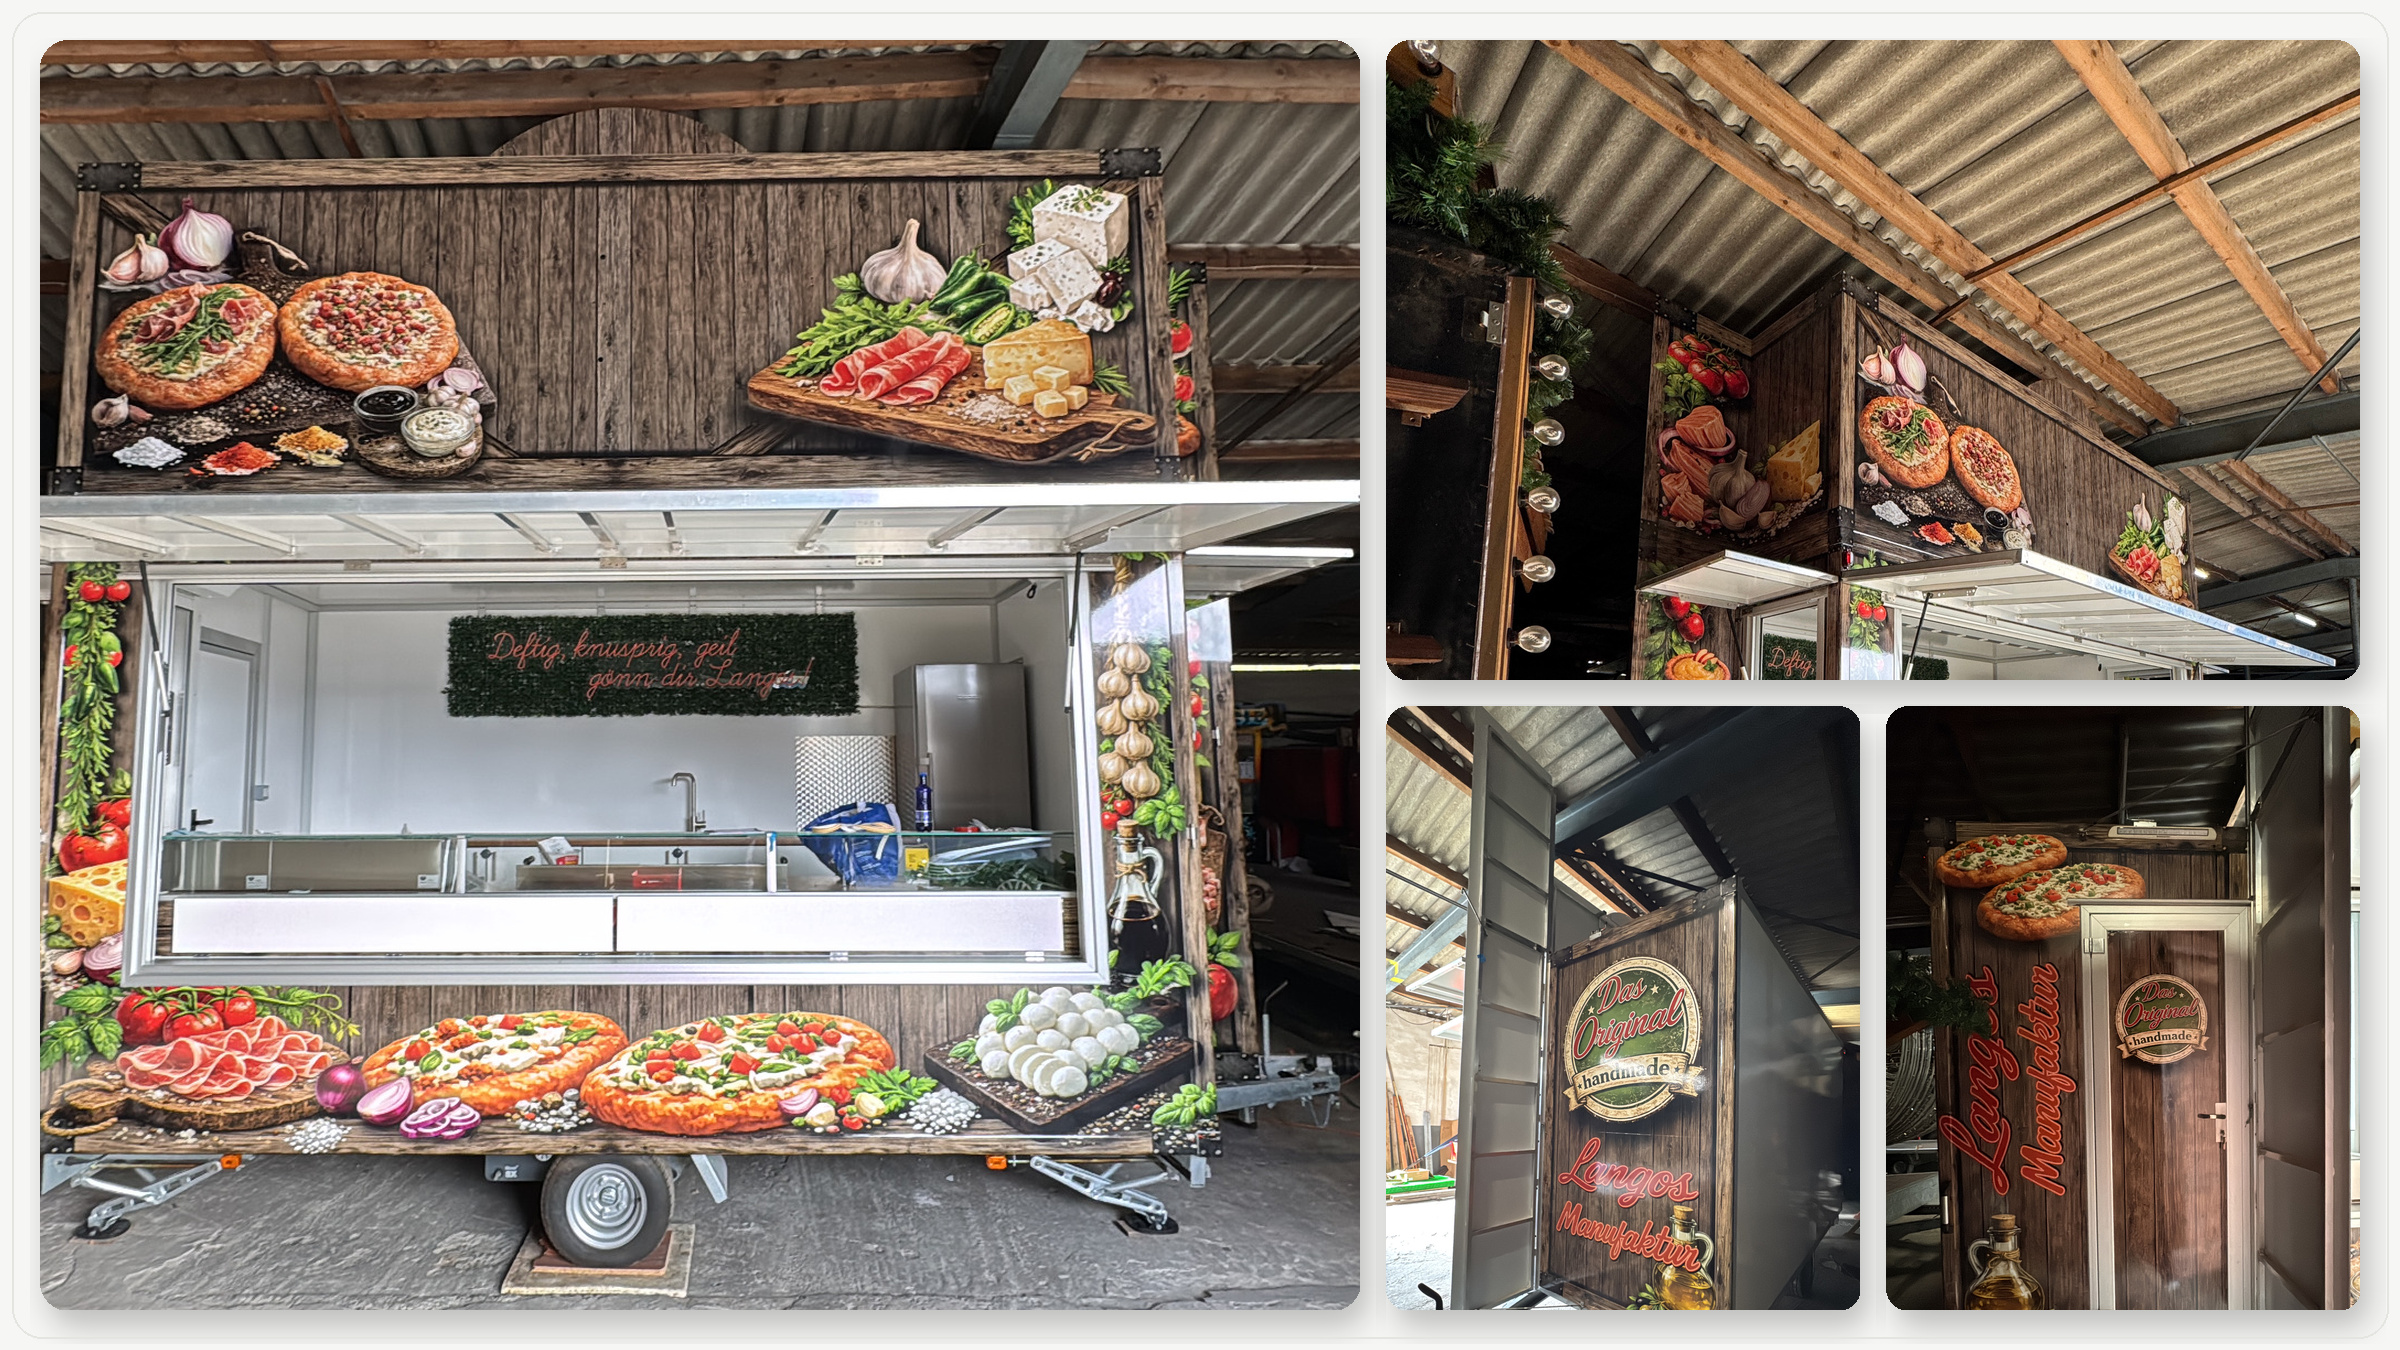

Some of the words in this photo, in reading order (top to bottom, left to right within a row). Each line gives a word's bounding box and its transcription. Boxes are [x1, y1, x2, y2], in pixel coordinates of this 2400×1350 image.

[487, 629, 566, 669] Deftig,
[573, 628, 684, 669] knusprig,
[696, 627, 741, 668] geil
[1767, 645, 1815, 679] Deftig,
[587, 668, 650, 701] gönn
[660, 664, 698, 688] dir
[1596, 975, 1647, 1015] Das
[2141, 981, 2178, 1002] Das
[1572, 987, 1687, 1059] Original
[2123, 997, 2200, 1030] Original
[2132, 1030, 2192, 1046] handmade
[1581, 1056, 1670, 1090] handmade
[1938, 965, 2020, 1196] Langs
[2016, 962, 2077, 1196] Manufaktur
[1557, 1137, 1700, 1209] Langos
[1555, 1200, 1702, 1273] Manufaktur
